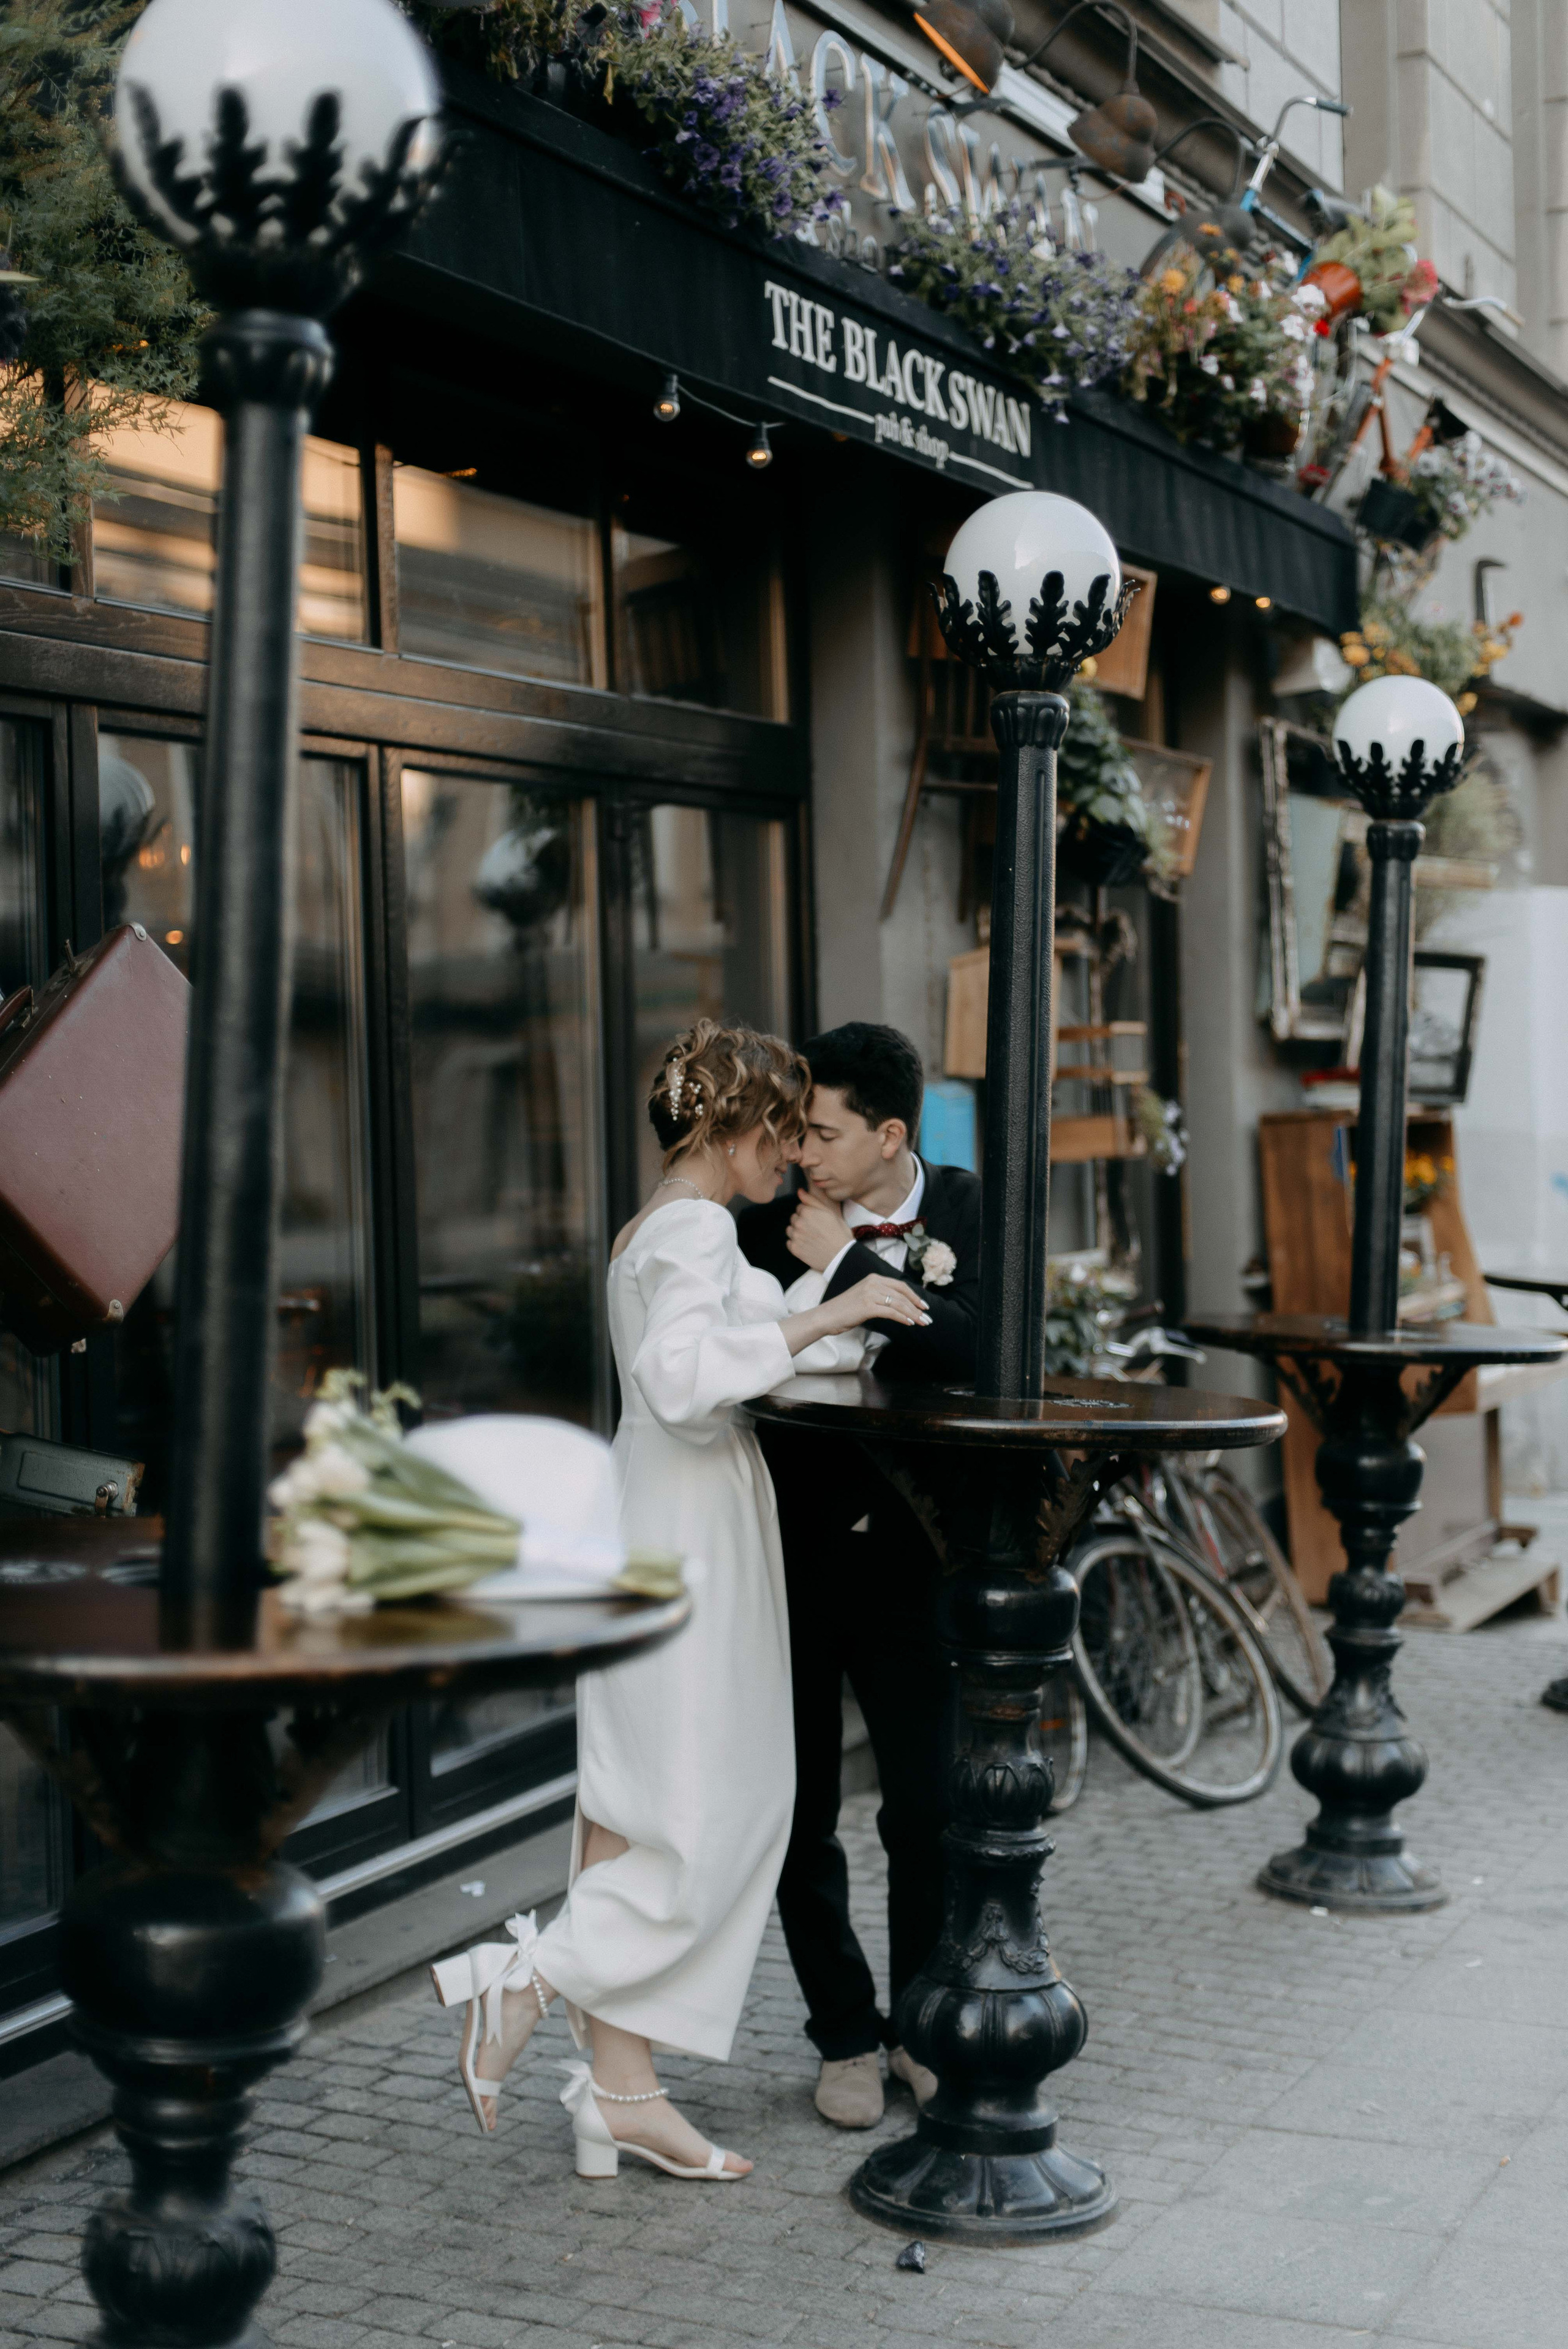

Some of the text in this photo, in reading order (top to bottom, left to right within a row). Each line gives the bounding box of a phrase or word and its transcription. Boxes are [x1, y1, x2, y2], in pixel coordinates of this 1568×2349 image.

[764, 279, 1031, 458] THE BLACK SWAN
[874, 411, 949, 470] pub & shop
